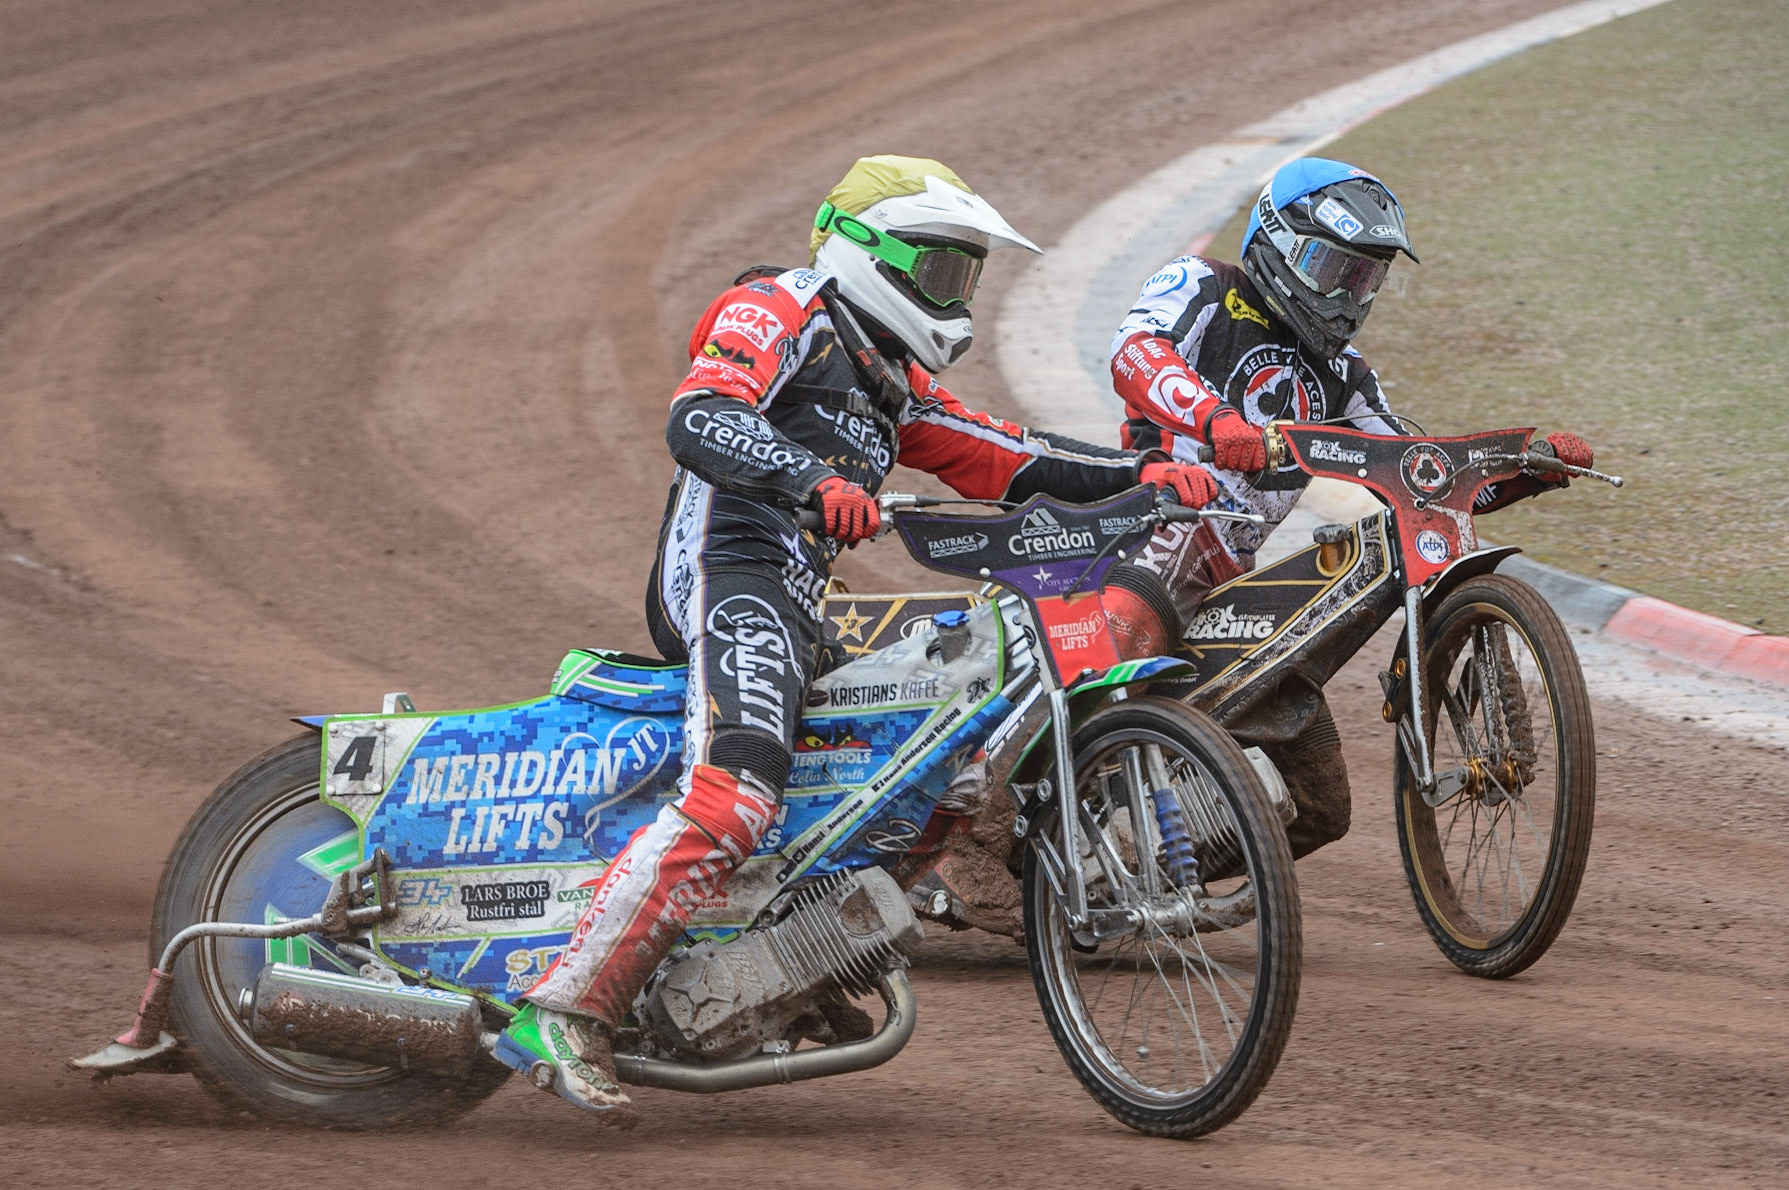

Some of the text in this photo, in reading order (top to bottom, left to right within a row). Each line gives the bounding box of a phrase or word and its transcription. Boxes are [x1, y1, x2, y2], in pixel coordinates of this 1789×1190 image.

[722, 305, 777, 339] NGK
[736, 325, 765, 347] PLUGS
[1115, 352, 1135, 381] Sport
[1124, 343, 1158, 379] Stiftung
[1243, 352, 1279, 377] BELLE
[1305, 381, 1321, 421] ACES
[684, 409, 812, 471] Crendon
[699, 438, 734, 458] TIMBER
[1309, 446, 1367, 465] RACING
[1099, 516, 1138, 528] FASTRACK
[928, 534, 975, 551] FASTRACK
[1008, 528, 1096, 556] Crendon
[1028, 551, 1053, 561] TIMBER
[1048, 620, 1097, 638] MERIDIAN
[1182, 619, 1274, 640] RACING
[1061, 635, 1089, 650] LIFTS
[830, 683, 897, 707] KRISTIANS
[900, 678, 939, 702] KAFFE
[933, 707, 962, 735] Racing
[333, 735, 377, 782] 4
[405, 747, 627, 806] MERIDIAN
[442, 801, 570, 856] LIFTS
[464, 883, 548, 902] LARS BROE
[470, 901, 543, 919] Rustfri stål
